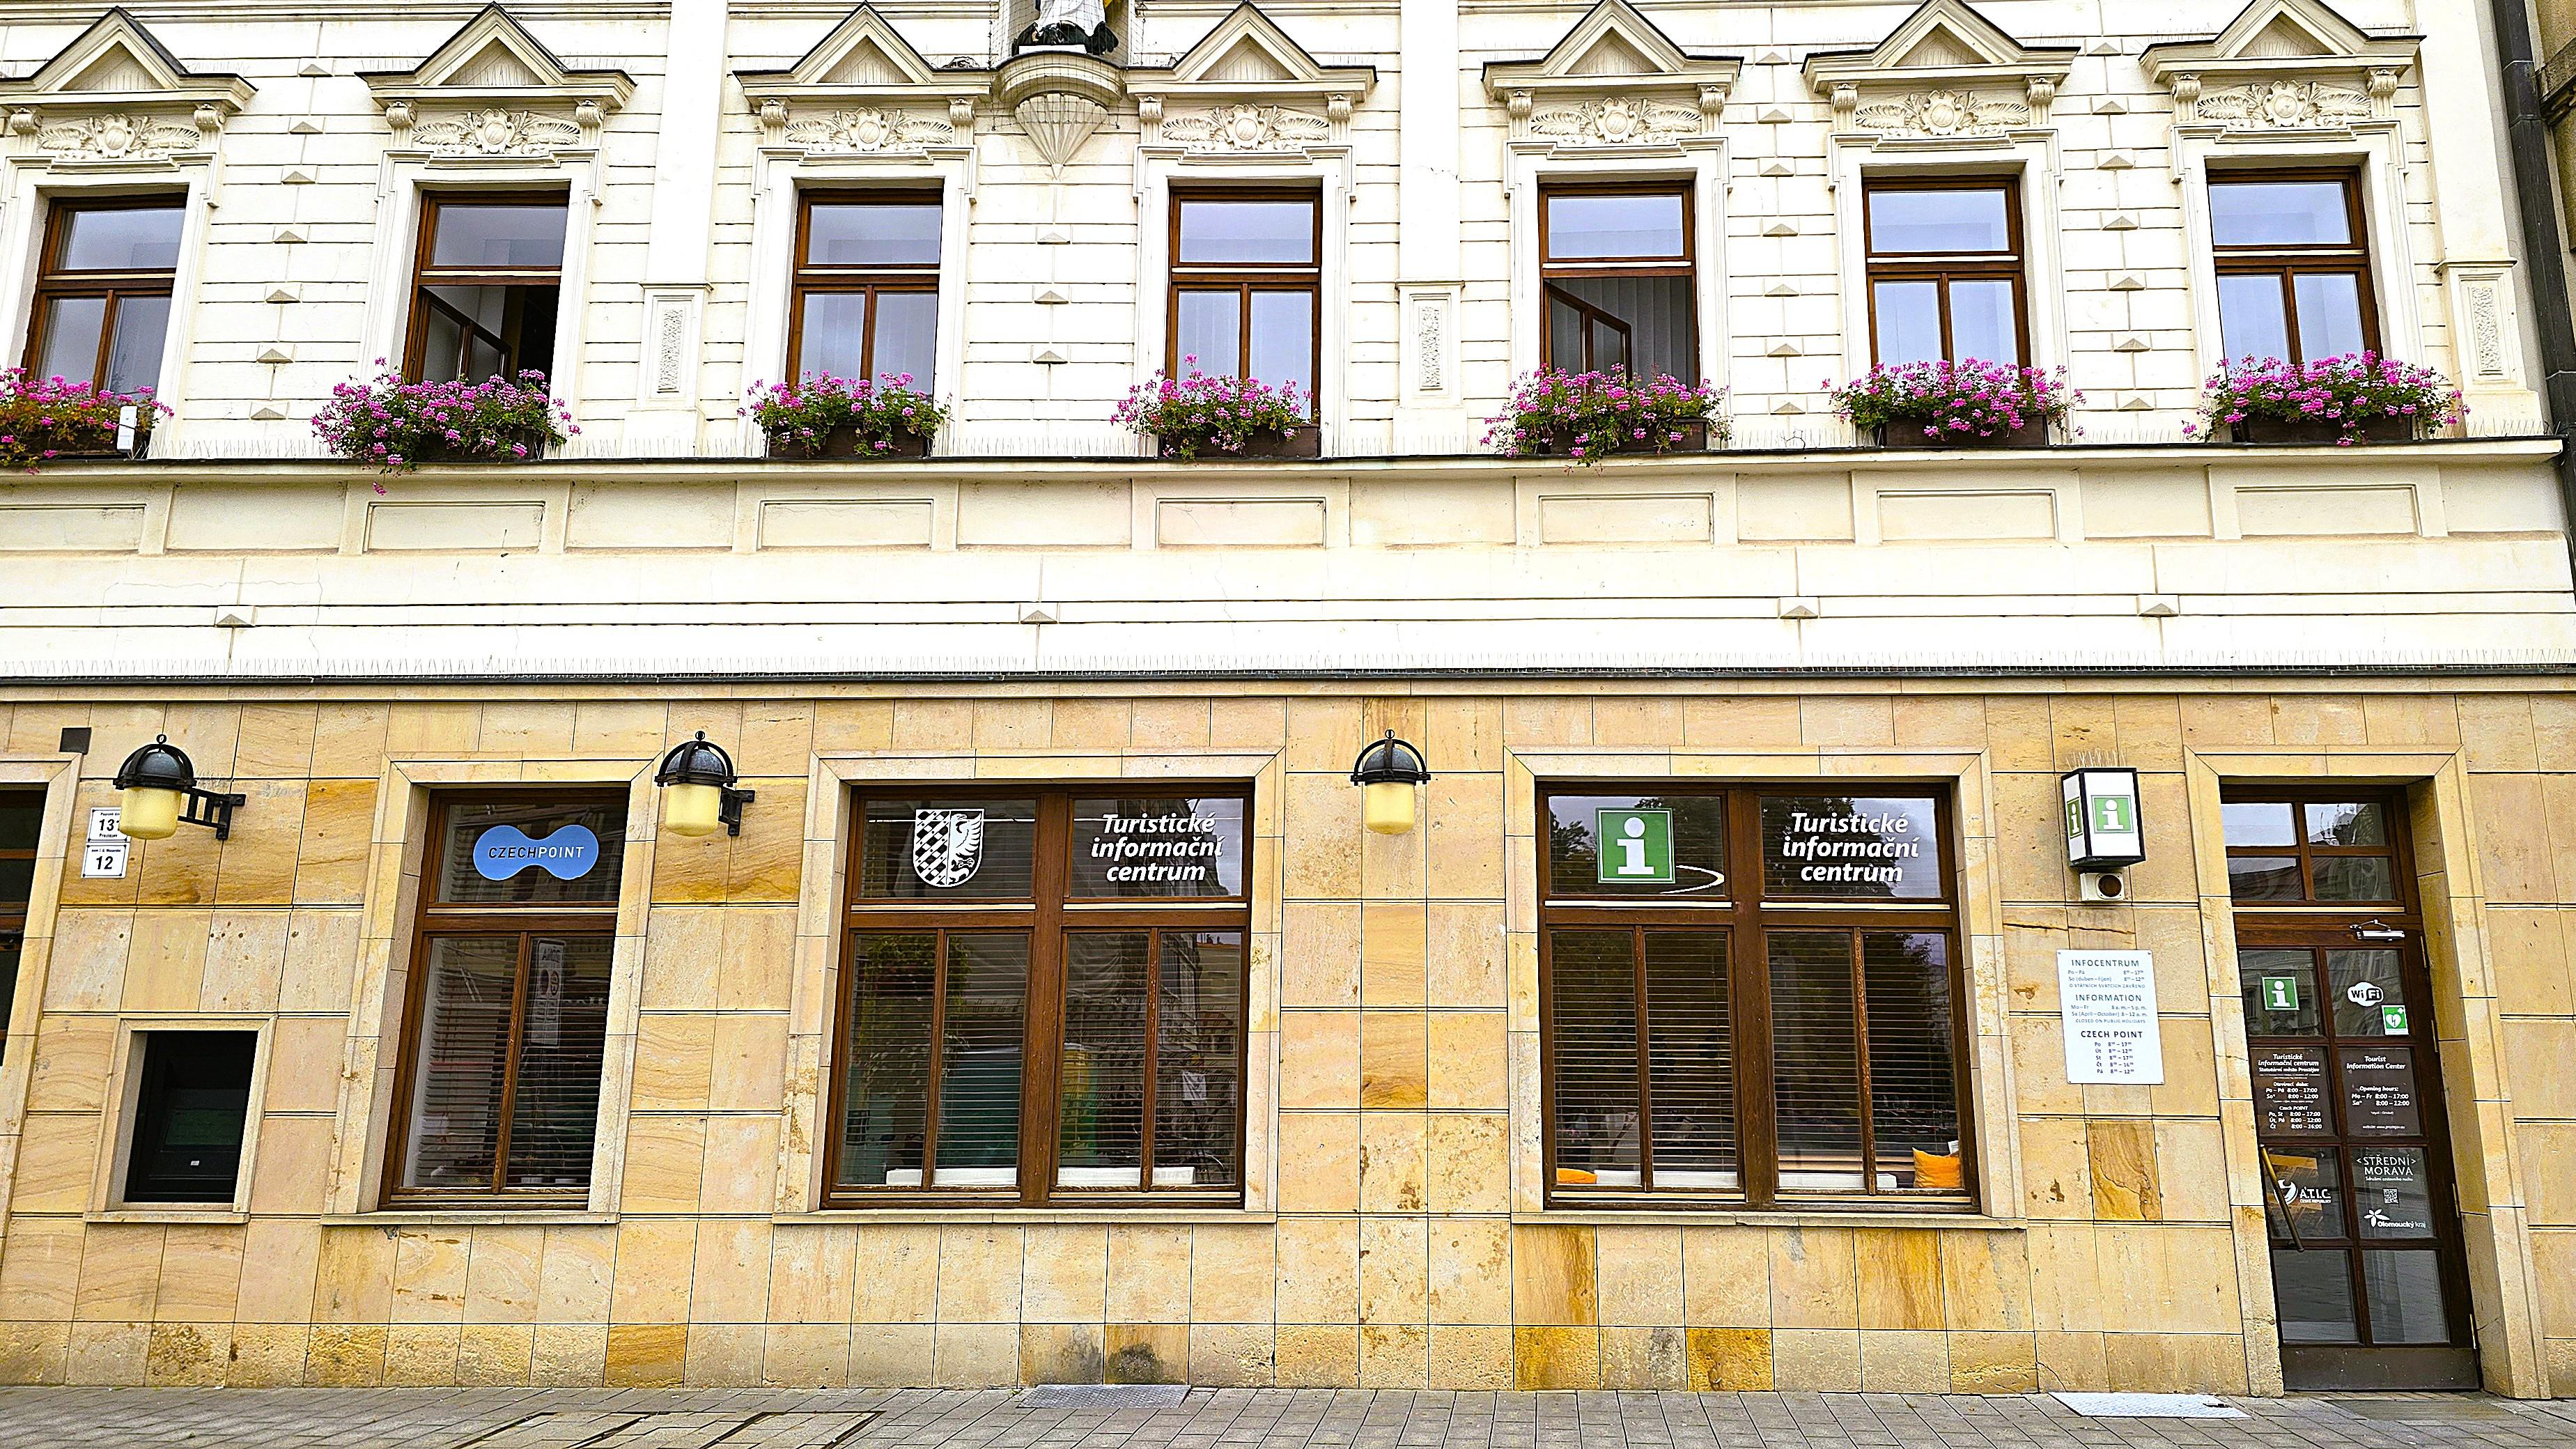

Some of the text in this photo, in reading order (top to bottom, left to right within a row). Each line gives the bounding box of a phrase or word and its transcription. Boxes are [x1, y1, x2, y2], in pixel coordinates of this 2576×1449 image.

[1103, 812, 1216, 834] Turistické
[1792, 812, 1909, 833] Turistické
[1091, 836, 1226, 862] informační
[1783, 836, 1921, 861] informační
[96, 855, 114, 870] 12
[1106, 862, 1205, 882] centrum
[1801, 862, 1903, 882] centrum
[2364, 1166, 2414, 1176] MORAVA
